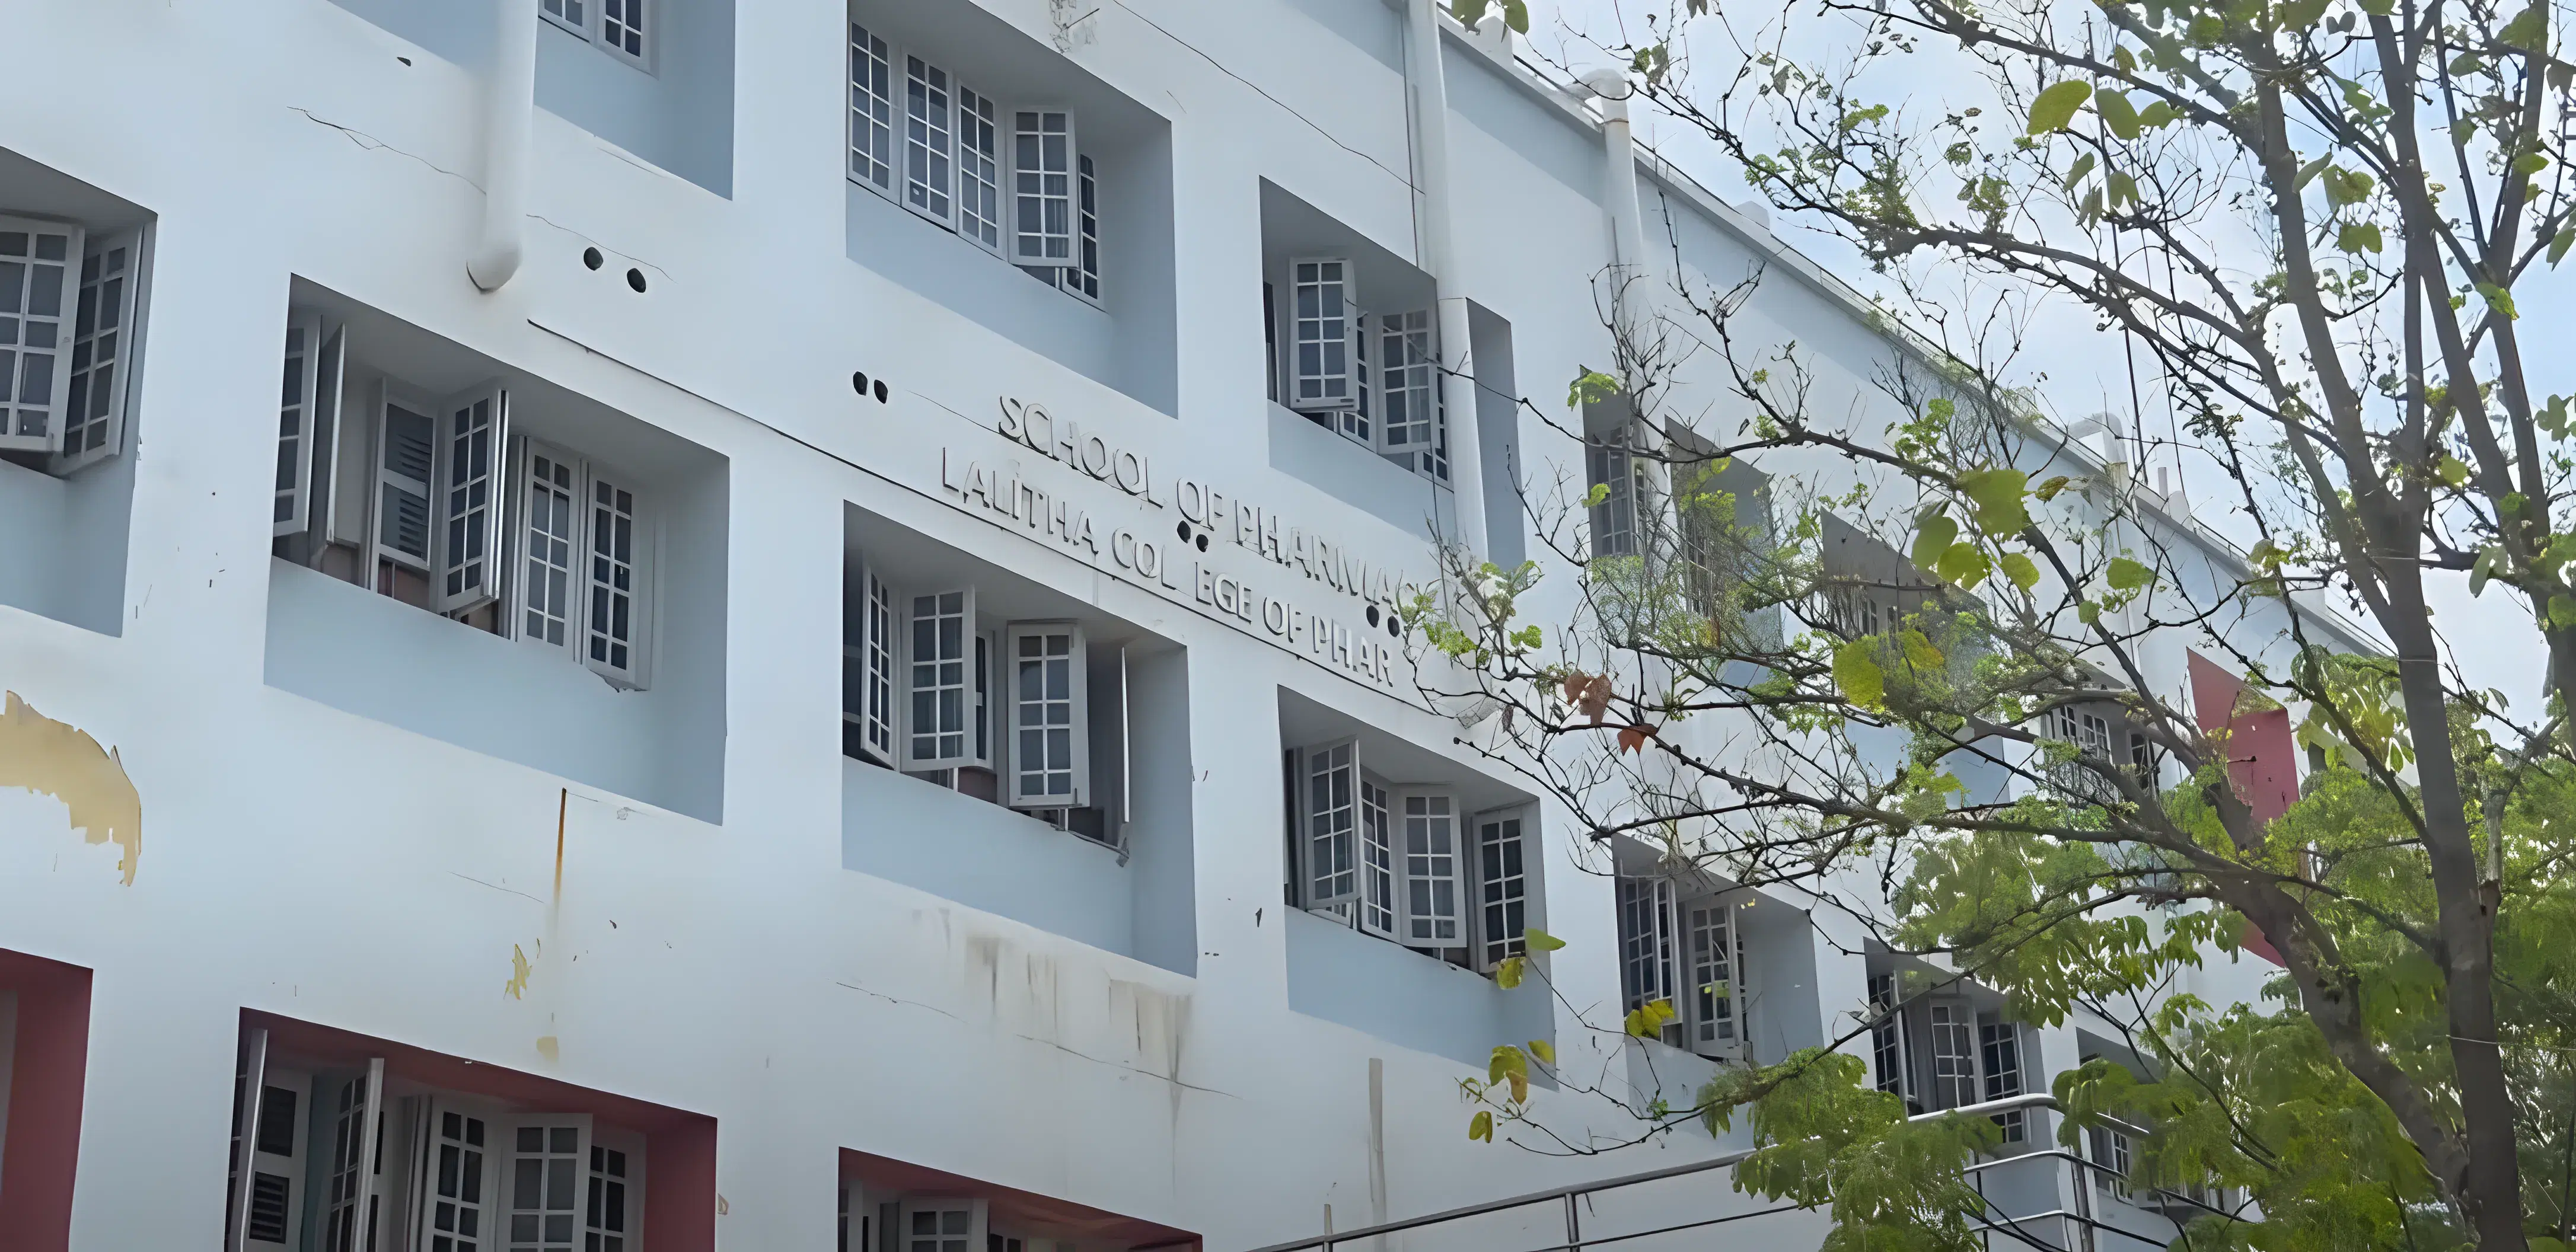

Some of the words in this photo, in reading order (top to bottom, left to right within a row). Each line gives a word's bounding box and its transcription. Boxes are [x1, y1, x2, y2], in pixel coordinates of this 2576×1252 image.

[943, 447, 1099, 555] LALITHA
[1263, 596, 1302, 643] OF
[998, 394, 1165, 509] SCHOOL
[1177, 477, 1223, 531] OF
